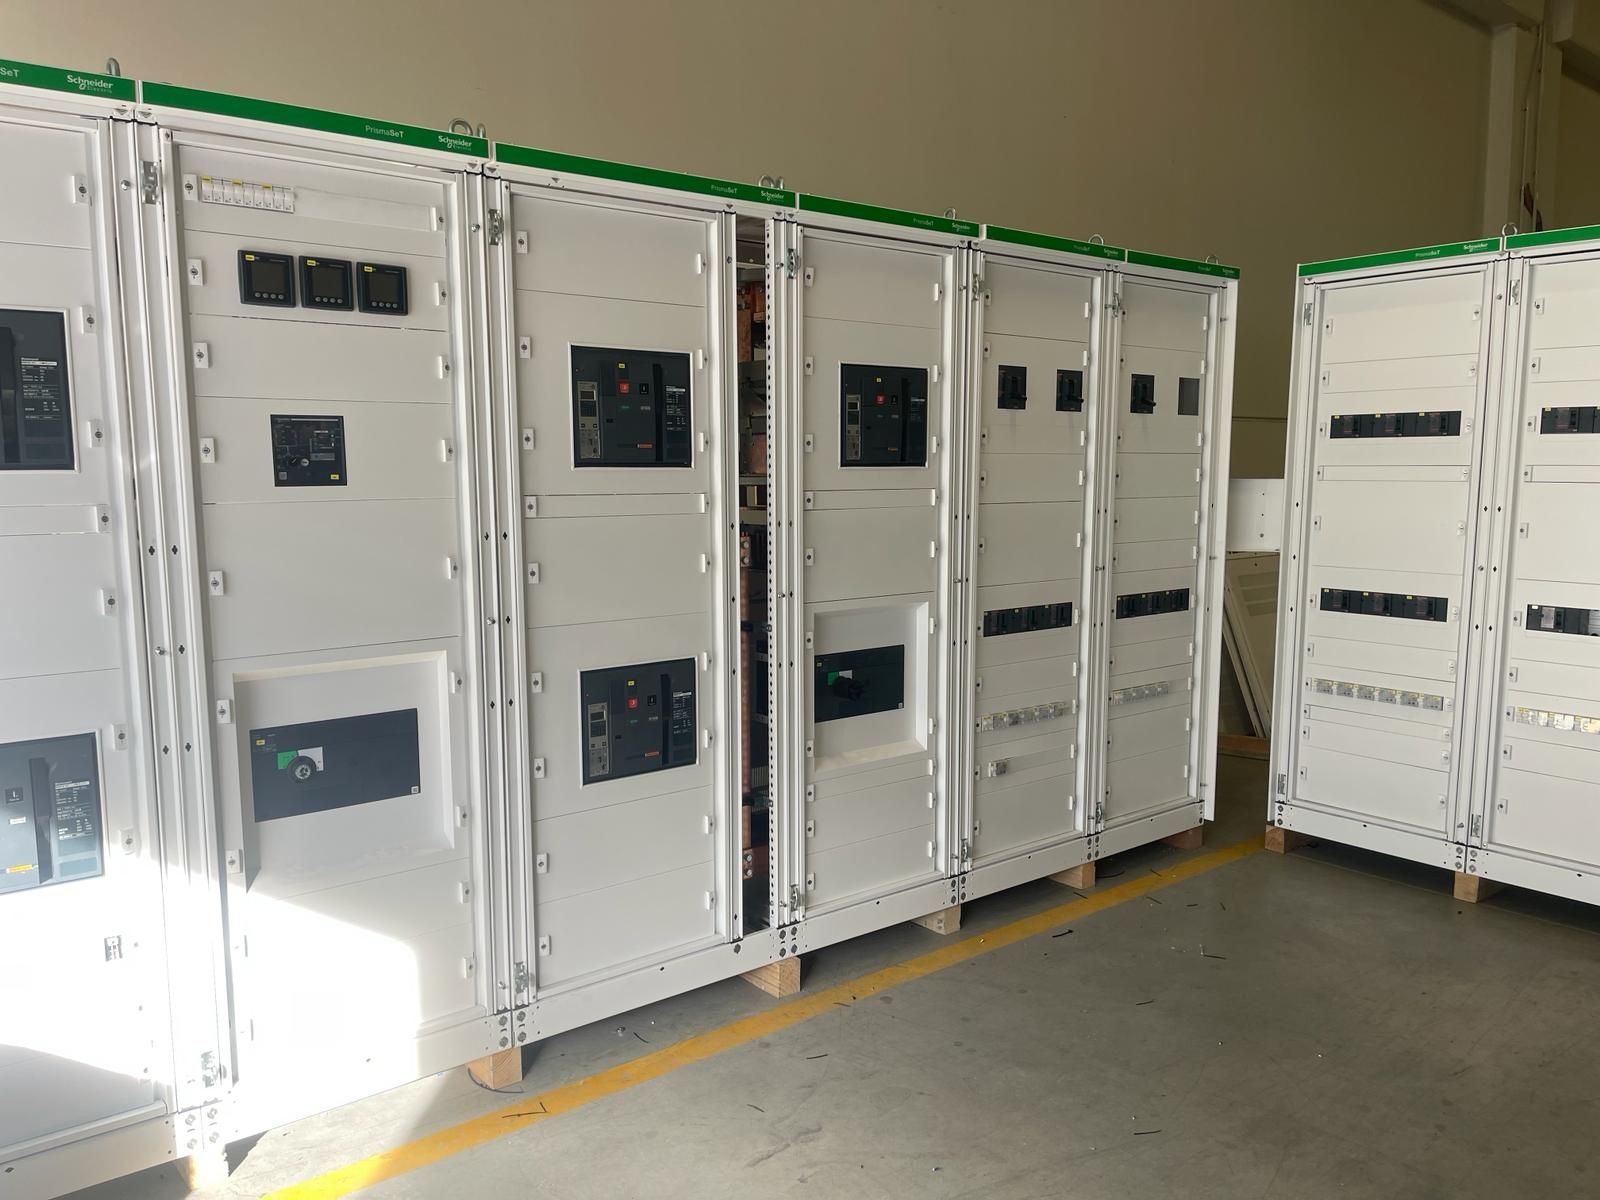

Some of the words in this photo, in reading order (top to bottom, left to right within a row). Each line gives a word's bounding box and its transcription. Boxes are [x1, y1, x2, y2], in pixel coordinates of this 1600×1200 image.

[66, 75, 113, 90] Schneider
[365, 125, 404, 138] PrismaSeT
[438, 135, 472, 149] Schneider
